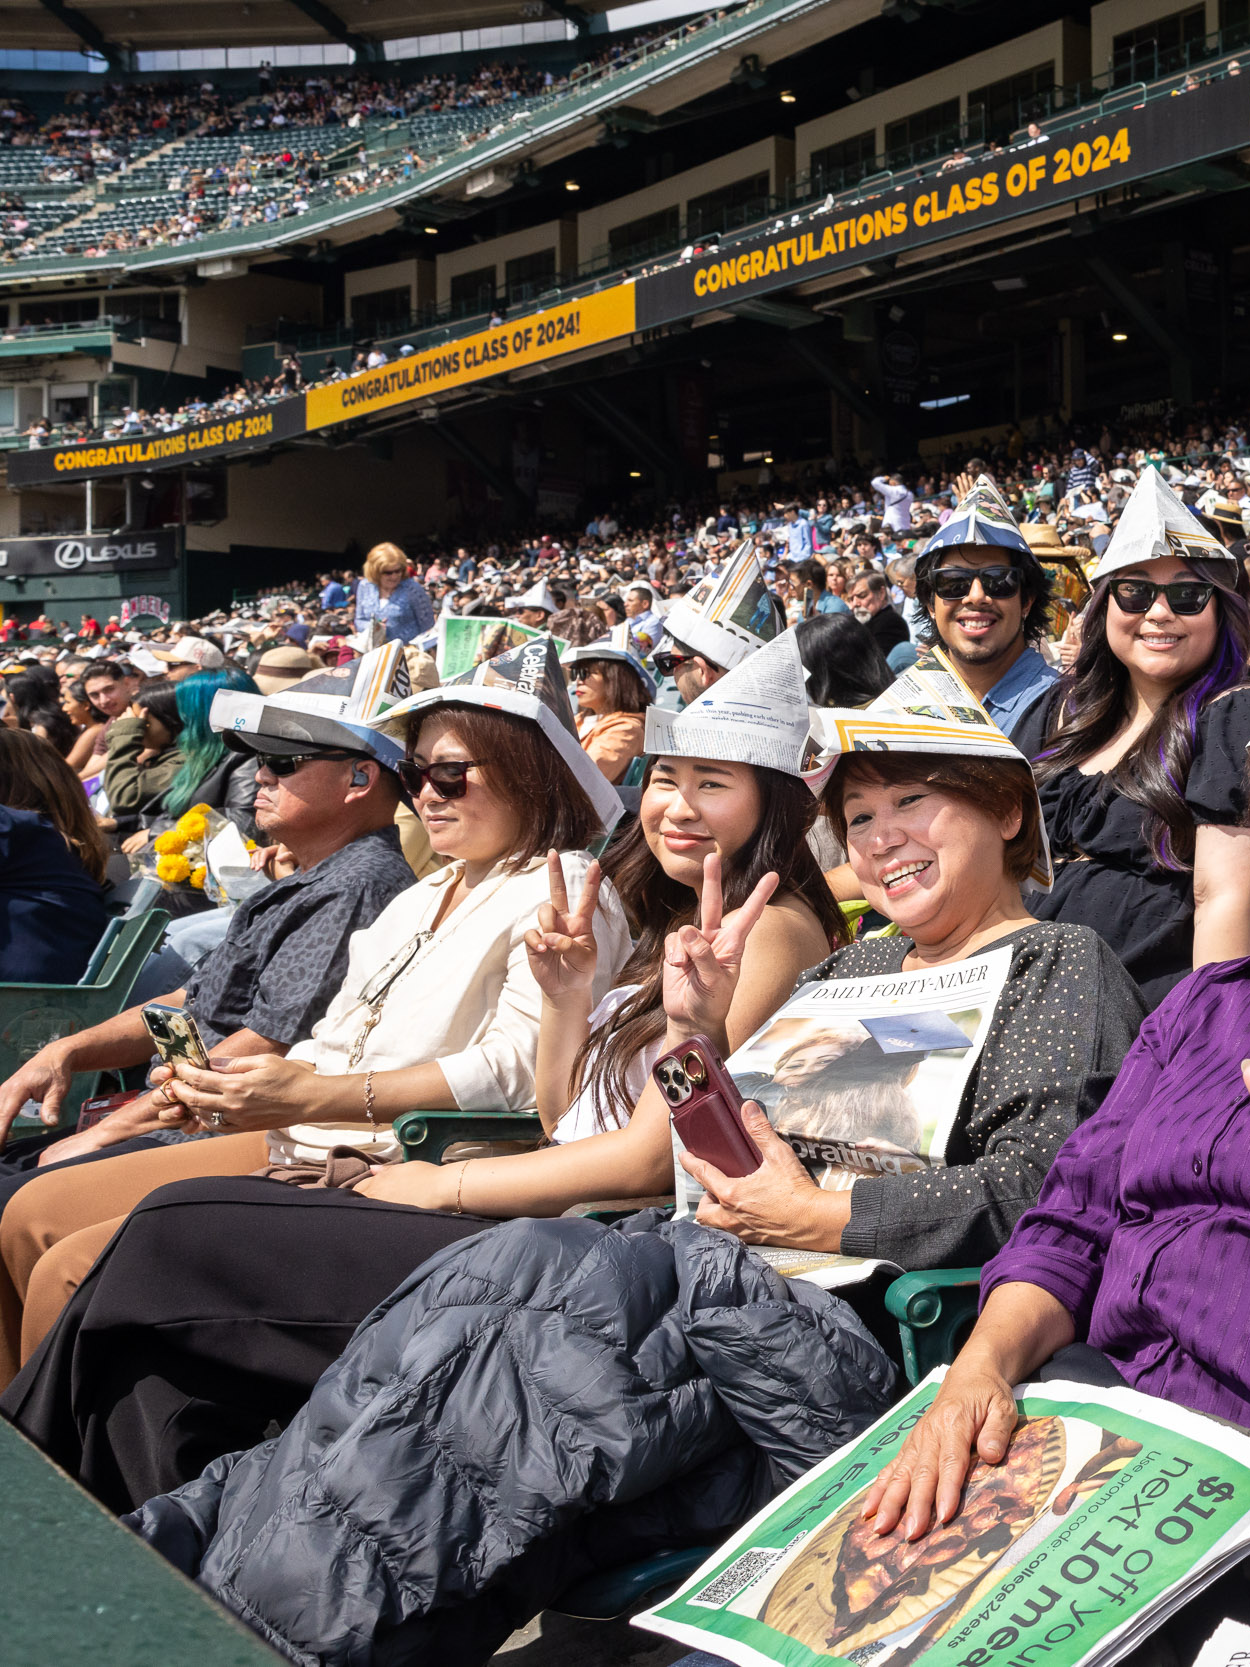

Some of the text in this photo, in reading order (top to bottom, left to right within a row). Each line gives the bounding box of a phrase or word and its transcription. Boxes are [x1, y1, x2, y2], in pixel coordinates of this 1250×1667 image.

[693, 127, 1131, 298] CONGRATULATIONS CLASS OF 2024
[341, 311, 581, 407] CONGRATULATIONS CLASS OF 2024!
[54, 413, 273, 472] CONGRATULATIONS CLASS OF 2024
[85, 543, 157, 562] LEXUS
[811, 964, 989, 1000] DAILY FORTY-NINER
[782, 1462, 869, 1532] Eats
[1107, 1456, 1194, 1531] next
[1154, 1476, 1236, 1545] $10
[947, 1450, 1162, 1649] use promo code: college24eats
[1060, 1531, 1123, 1584] 10
[1097, 1549, 1154, 1607] off
